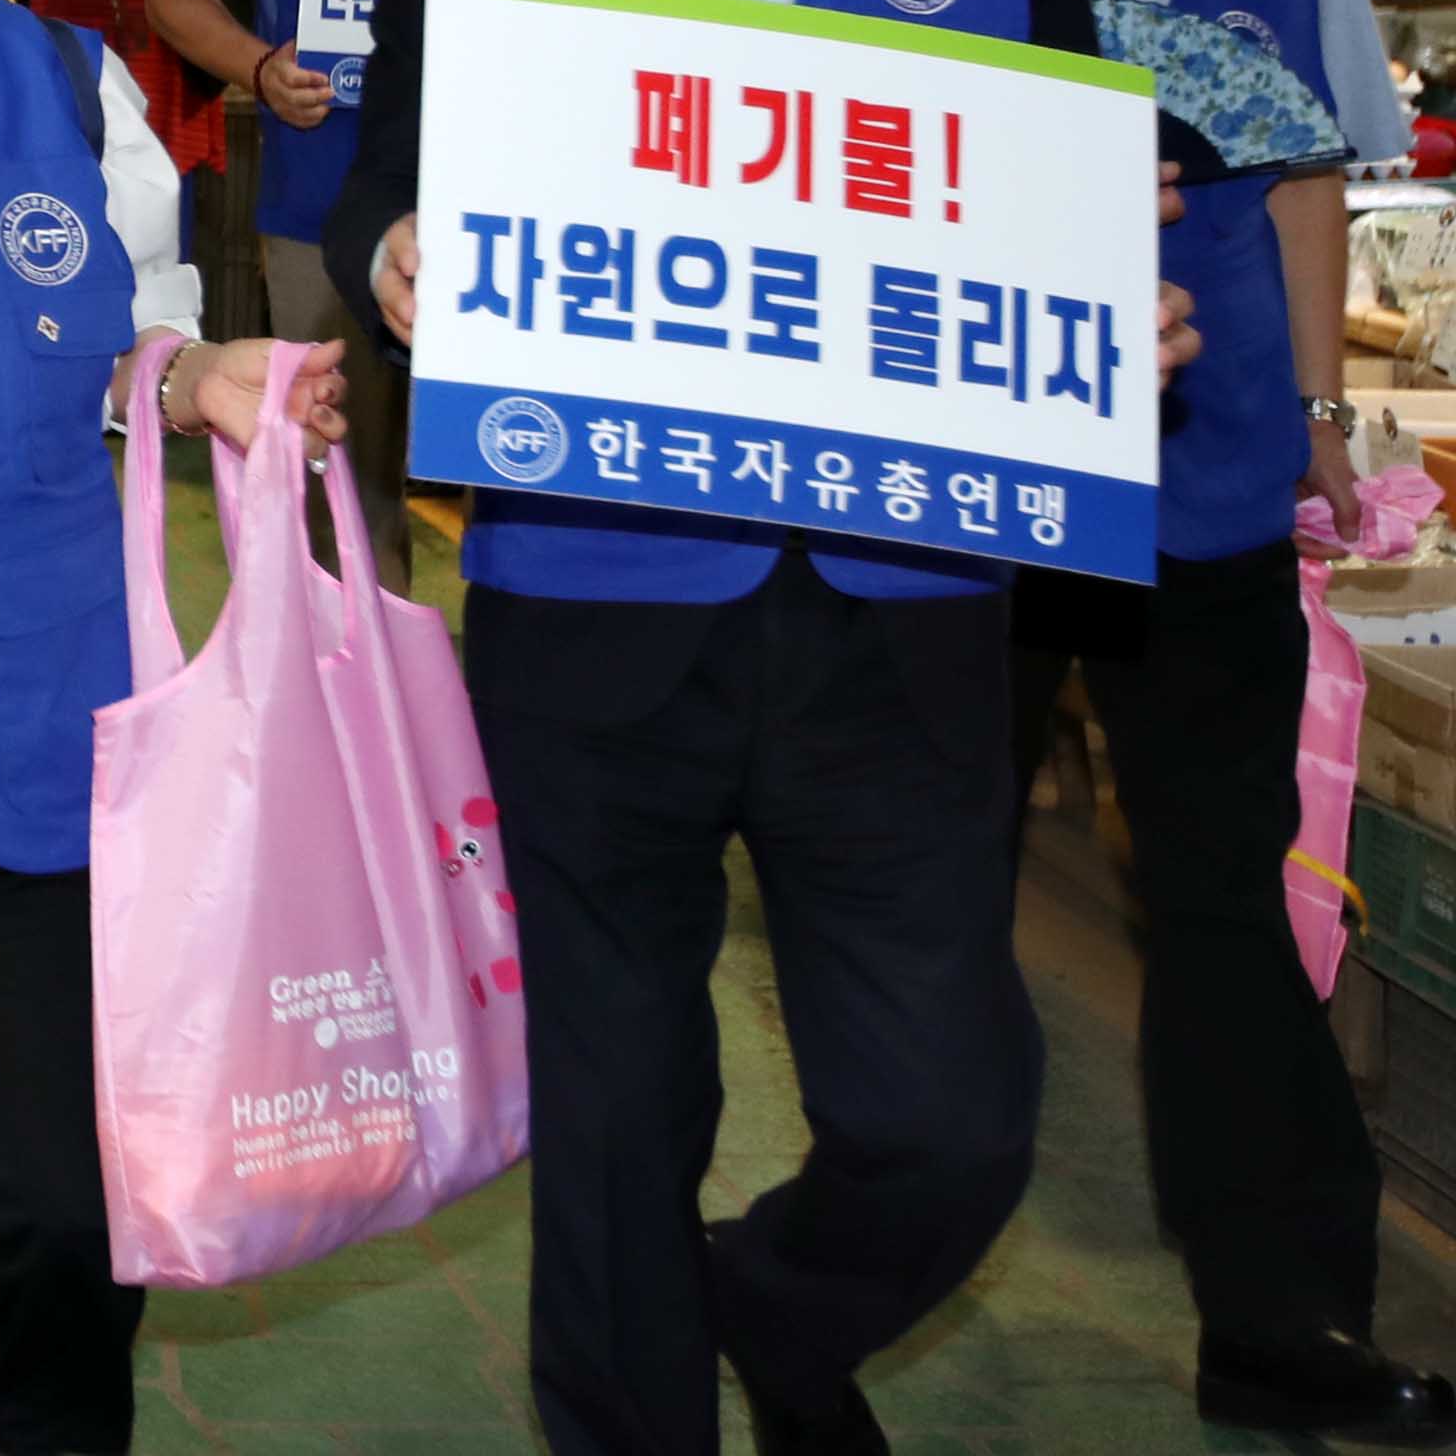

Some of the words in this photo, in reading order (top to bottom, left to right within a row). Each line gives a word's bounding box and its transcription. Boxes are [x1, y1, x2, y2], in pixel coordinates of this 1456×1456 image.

[630, 68, 964, 225] 폐기물!
[456, 211, 822, 363] 자원으로
[868, 262, 1120, 420] 돌리자
[586, 418, 1068, 548] 한국자유총연맹
[270, 969, 352, 1003] Green
[231, 1083, 329, 1129] Happy
